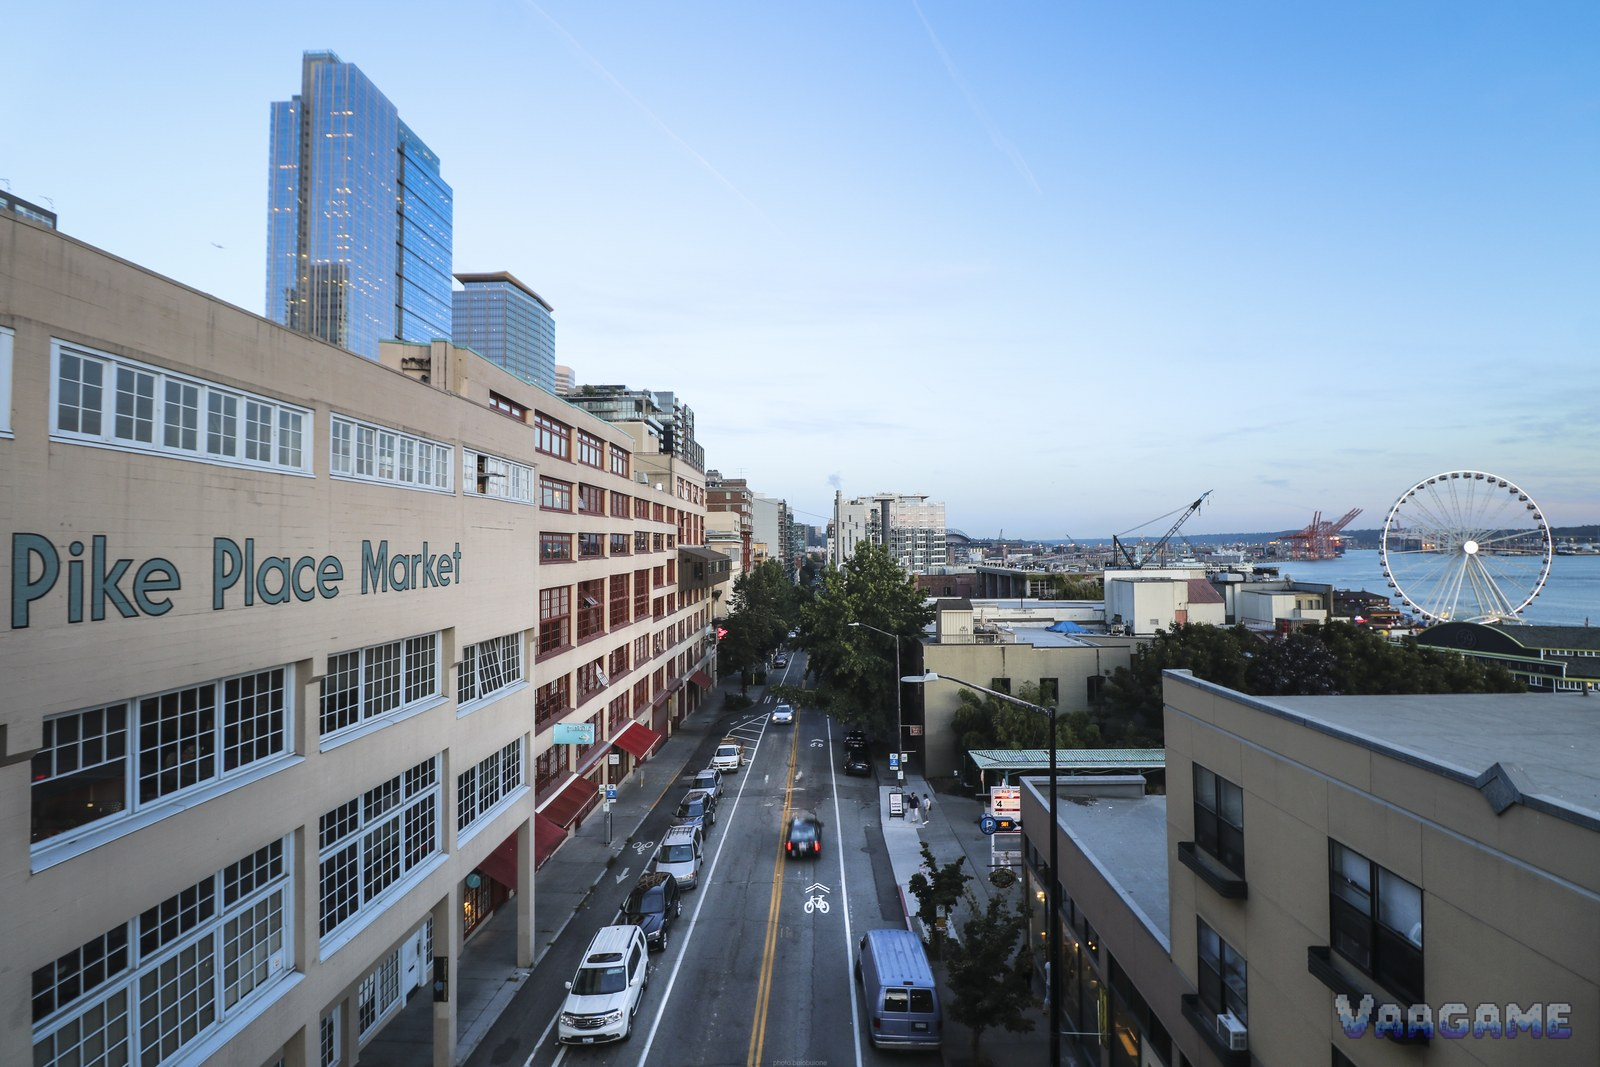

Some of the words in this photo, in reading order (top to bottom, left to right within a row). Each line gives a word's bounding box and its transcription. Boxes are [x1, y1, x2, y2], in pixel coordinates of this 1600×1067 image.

[11, 532, 181, 629] Pike
[213, 536, 344, 610] Place
[361, 539, 462, 595] Market
